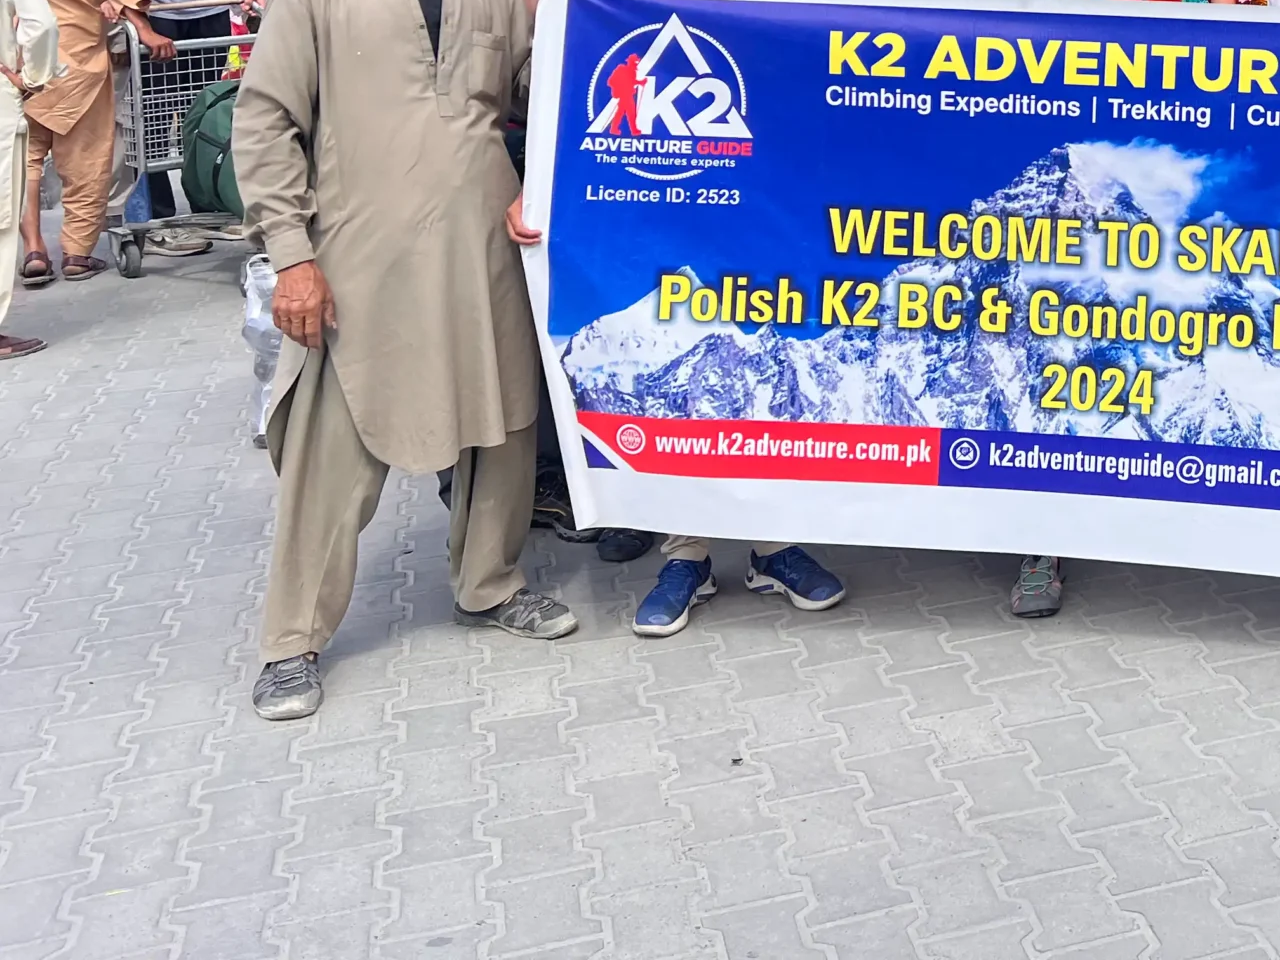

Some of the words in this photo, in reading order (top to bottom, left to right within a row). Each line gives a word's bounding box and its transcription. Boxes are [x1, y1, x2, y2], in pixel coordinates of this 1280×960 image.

[828, 30, 907, 78] K2
[638, 74, 754, 138] K2
[825, 85, 932, 114] Climbing
[939, 90, 1081, 117] Expeditions
[1108, 97, 1212, 129] Trekking
[579, 136, 693, 155] ADVENTURE
[696, 140, 753, 156] GUIDE
[594, 153, 618, 164] The
[620, 154, 687, 166] adventures
[690, 156, 736, 169] experts
[585, 184, 661, 203] Licence
[665, 187, 691, 204] ID:
[696, 188, 741, 205] 2523
[829, 207, 1082, 265] WELCOME
[1097, 220, 1161, 269] TO
[657, 273, 804, 325] Polish
[821, 279, 881, 327] K2
[897, 282, 963, 331] BC
[978, 287, 1013, 333] &
[1028, 288, 1255, 357] Gondogro
[1040, 364, 1155, 415] 2024
[655, 431, 932, 467] www.k2adventure.com.pk
